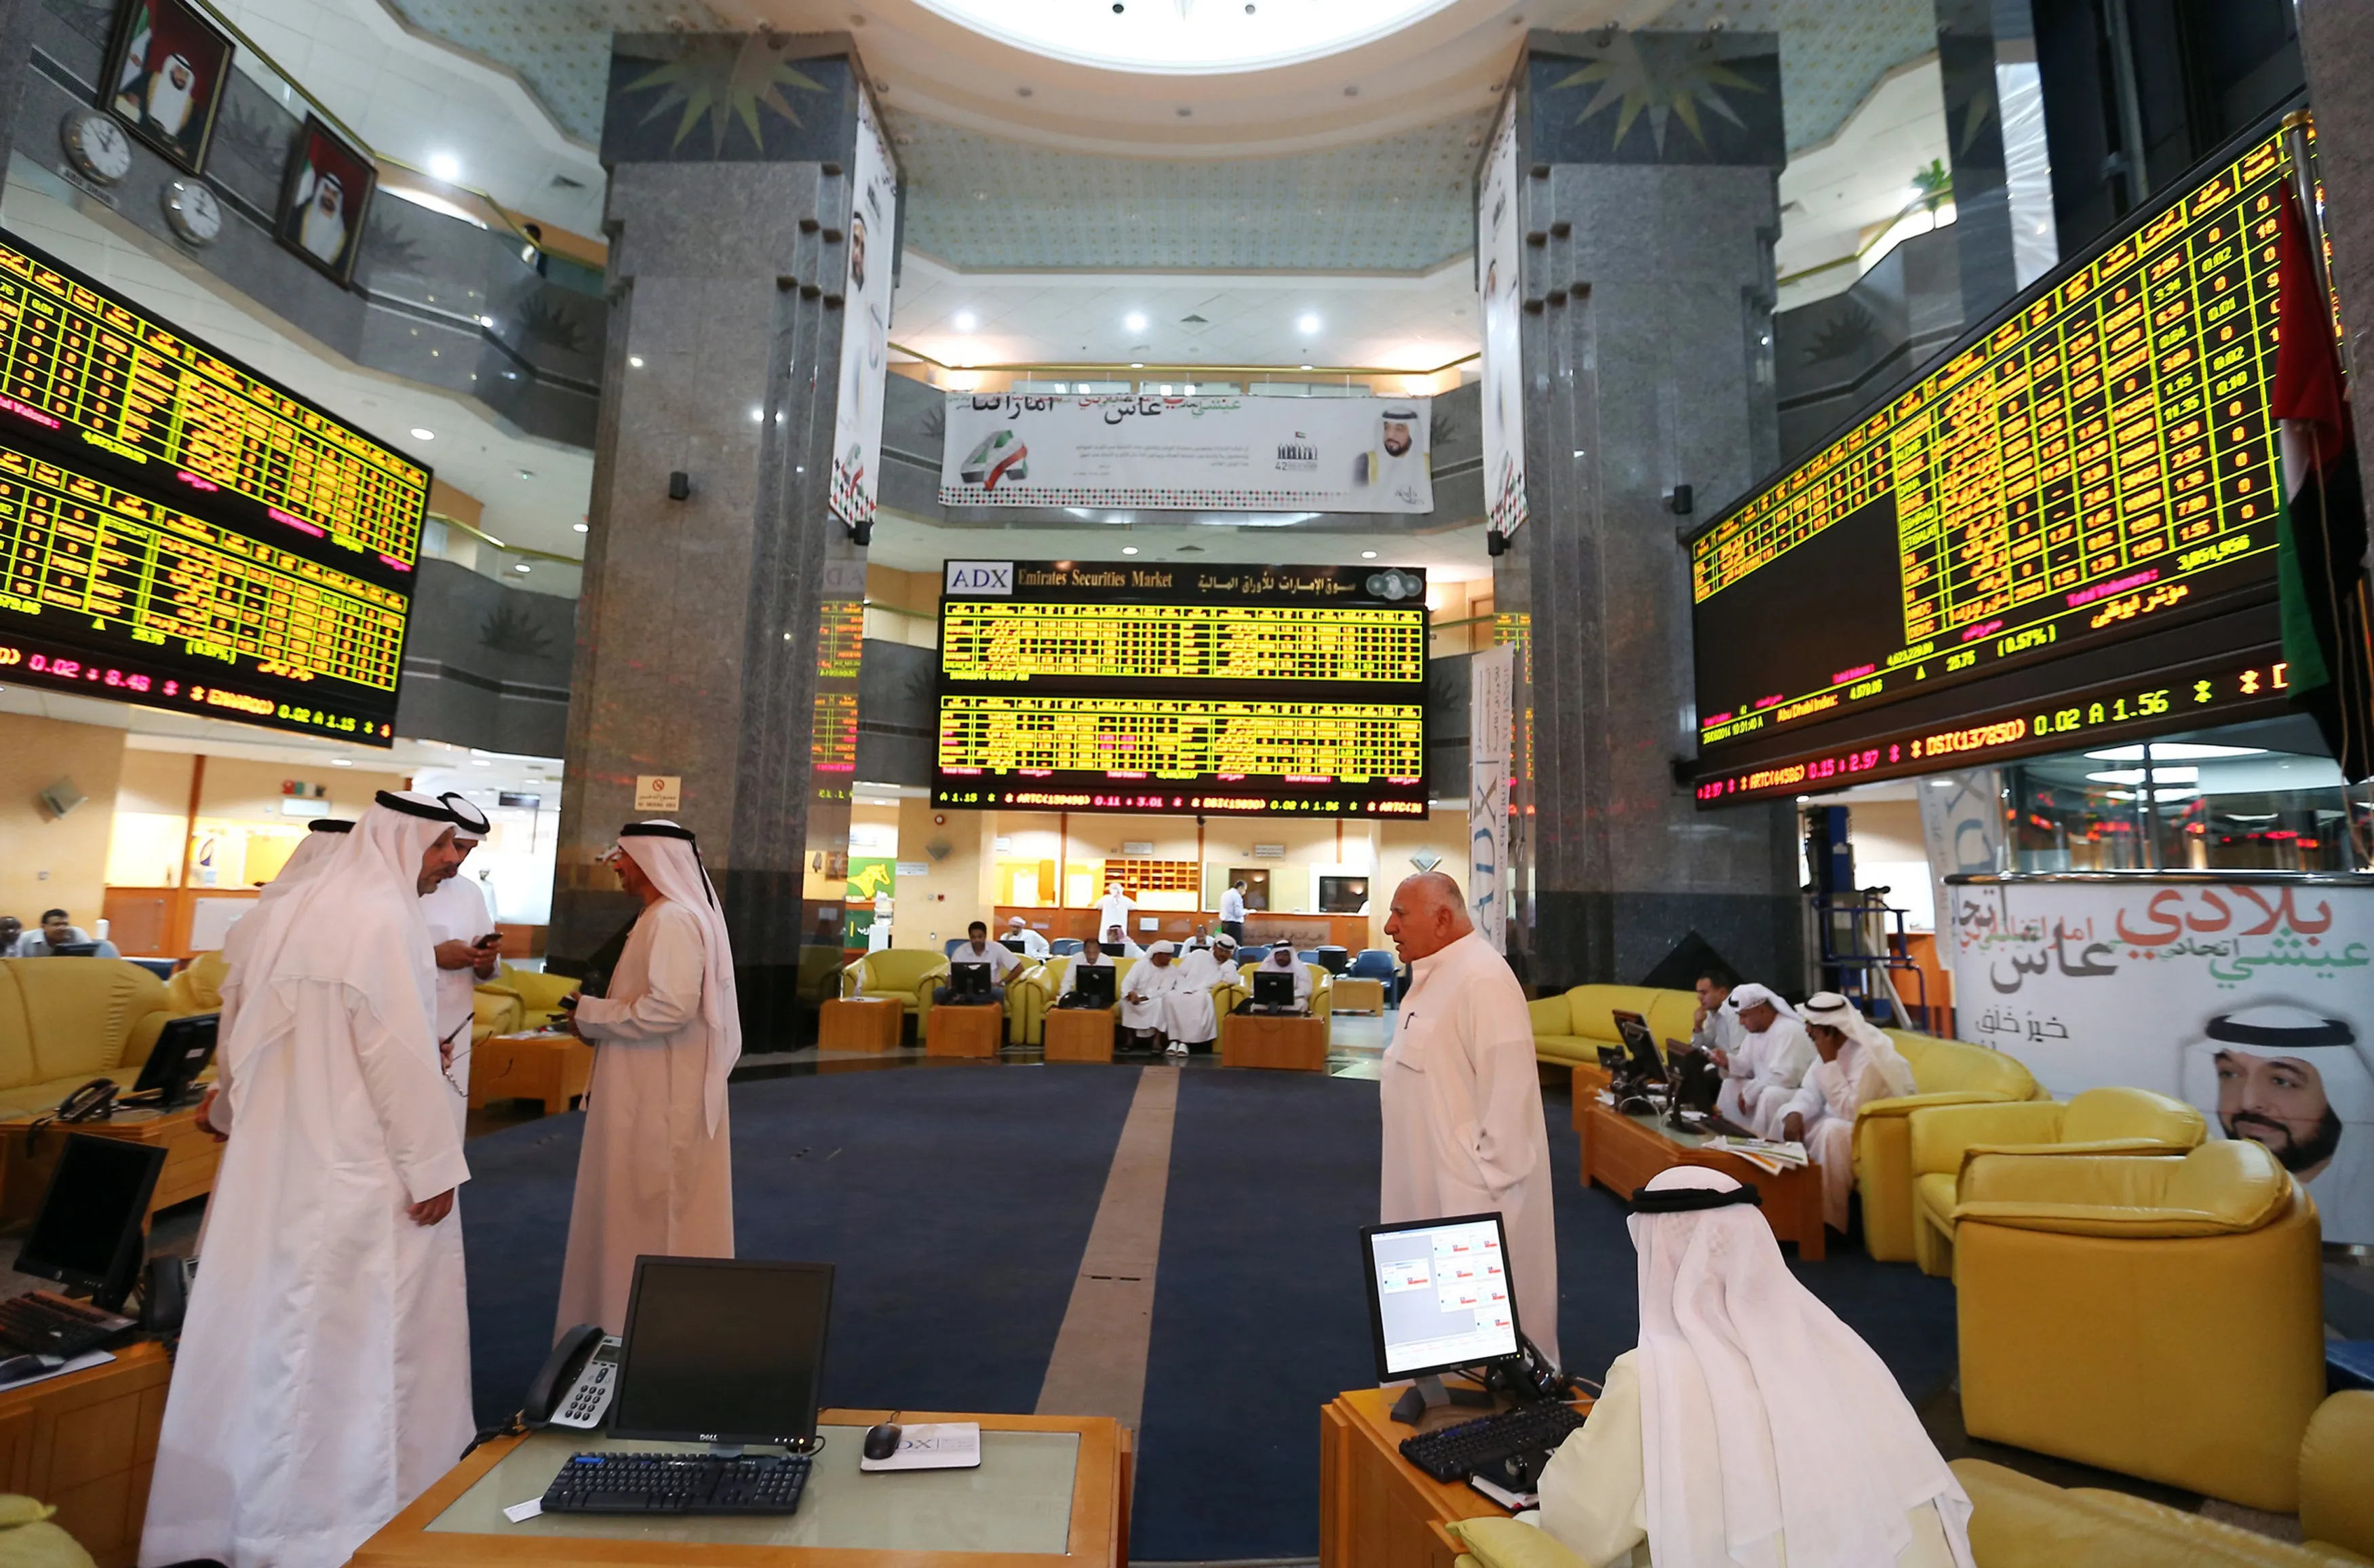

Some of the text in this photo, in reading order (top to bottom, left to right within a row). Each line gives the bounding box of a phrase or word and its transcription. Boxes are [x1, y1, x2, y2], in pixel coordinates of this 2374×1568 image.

[1275, 462, 1287, 471] 42
[952, 569, 1009, 588] ADX
[1018, 569, 1172, 587] Emirates Securities Market
[1325, 579, 1356, 595] سوق
[28, 654, 81, 678] 0.02
[1776, 708, 1793, 723] Abu
[1793, 700, 1814, 720] Dhabi
[1848, 749, 1880, 771] 2.97
[2034, 708, 2080, 737] 0.02
[2113, 690, 2169, 722] 1.56
[1270, 800, 1297, 810] 0.02
[1472, 776, 1498, 941] ADX
[2115, 886, 2333, 960] بلادي
[2208, 926, 2371, 989] عيشي
